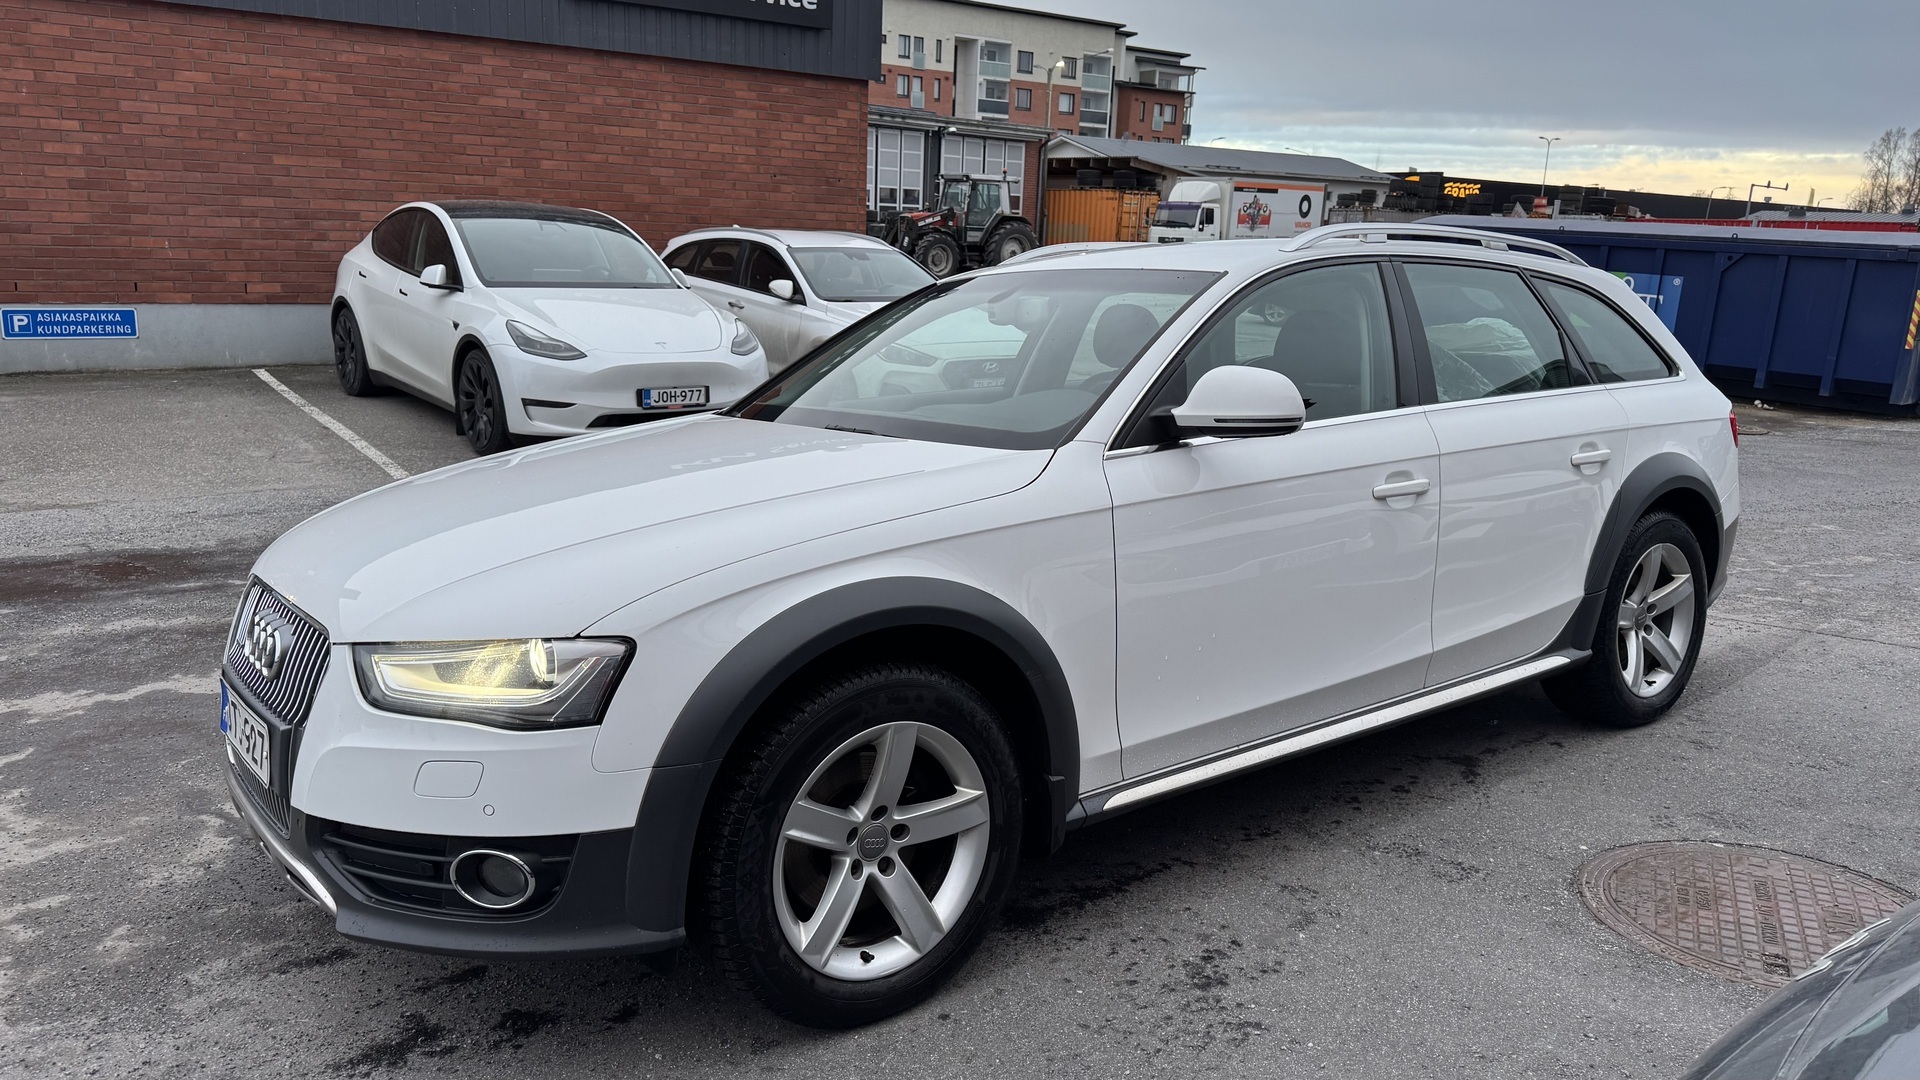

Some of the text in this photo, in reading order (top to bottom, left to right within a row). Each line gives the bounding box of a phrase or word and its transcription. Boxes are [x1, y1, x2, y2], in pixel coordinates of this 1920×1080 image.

[37, 313, 121, 322] ASIAKASPAIKKA
[37, 325, 131, 334] KUNDPARKERING
[653, 389, 702, 403] JOH-977
